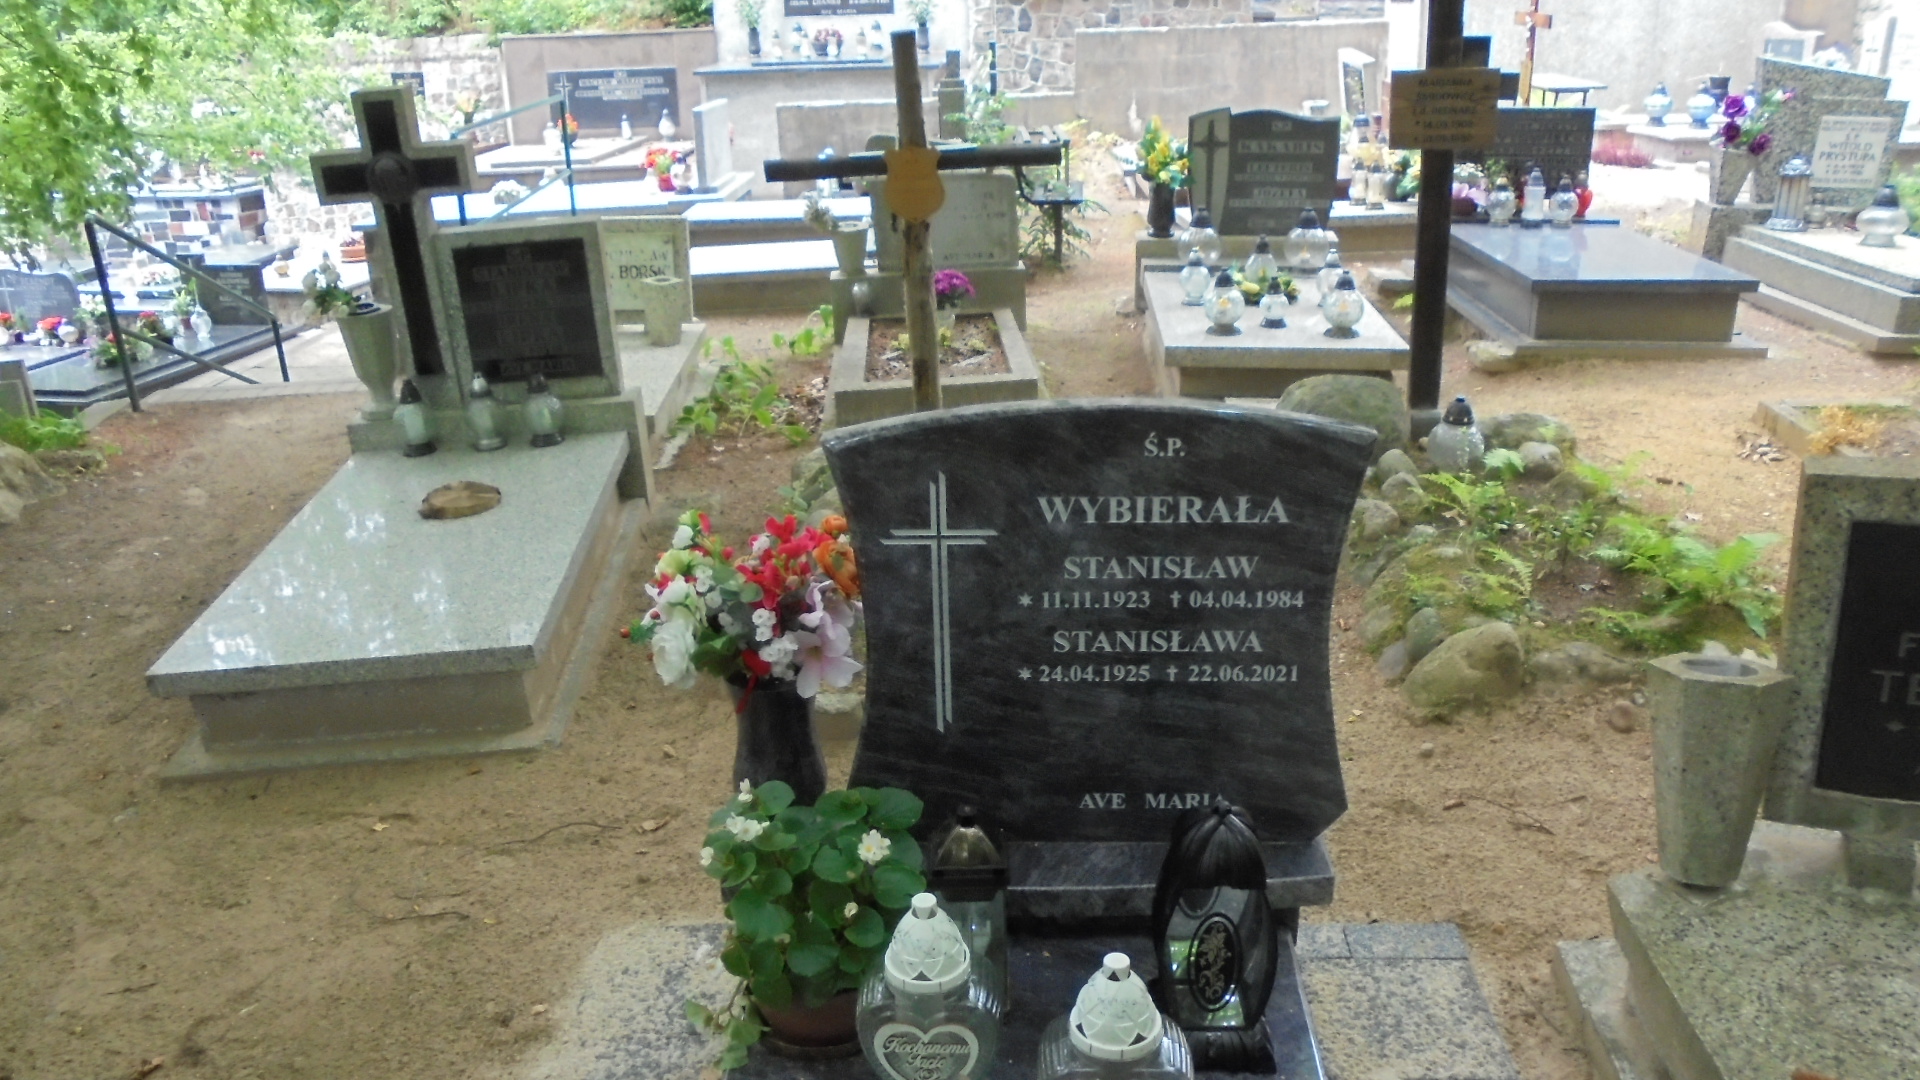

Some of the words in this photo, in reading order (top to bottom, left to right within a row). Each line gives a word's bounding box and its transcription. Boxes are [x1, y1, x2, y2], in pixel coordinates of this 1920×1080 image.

[1144, 432, 1185, 457] Ś.P.
[1038, 496, 1289, 524] WYBIERAŁA
[1064, 556, 1258, 579] STANISŁAW
[1042, 591, 1150, 608] 11.11.1923
[1190, 591, 1304, 608] 04.04.1984
[1053, 630, 1263, 653] STANISŁAWA
[1039, 665, 1150, 682] 24.04.1925
[1188, 665, 1298, 682] 22.06.2021
[1079, 793, 1126, 809] AVE
